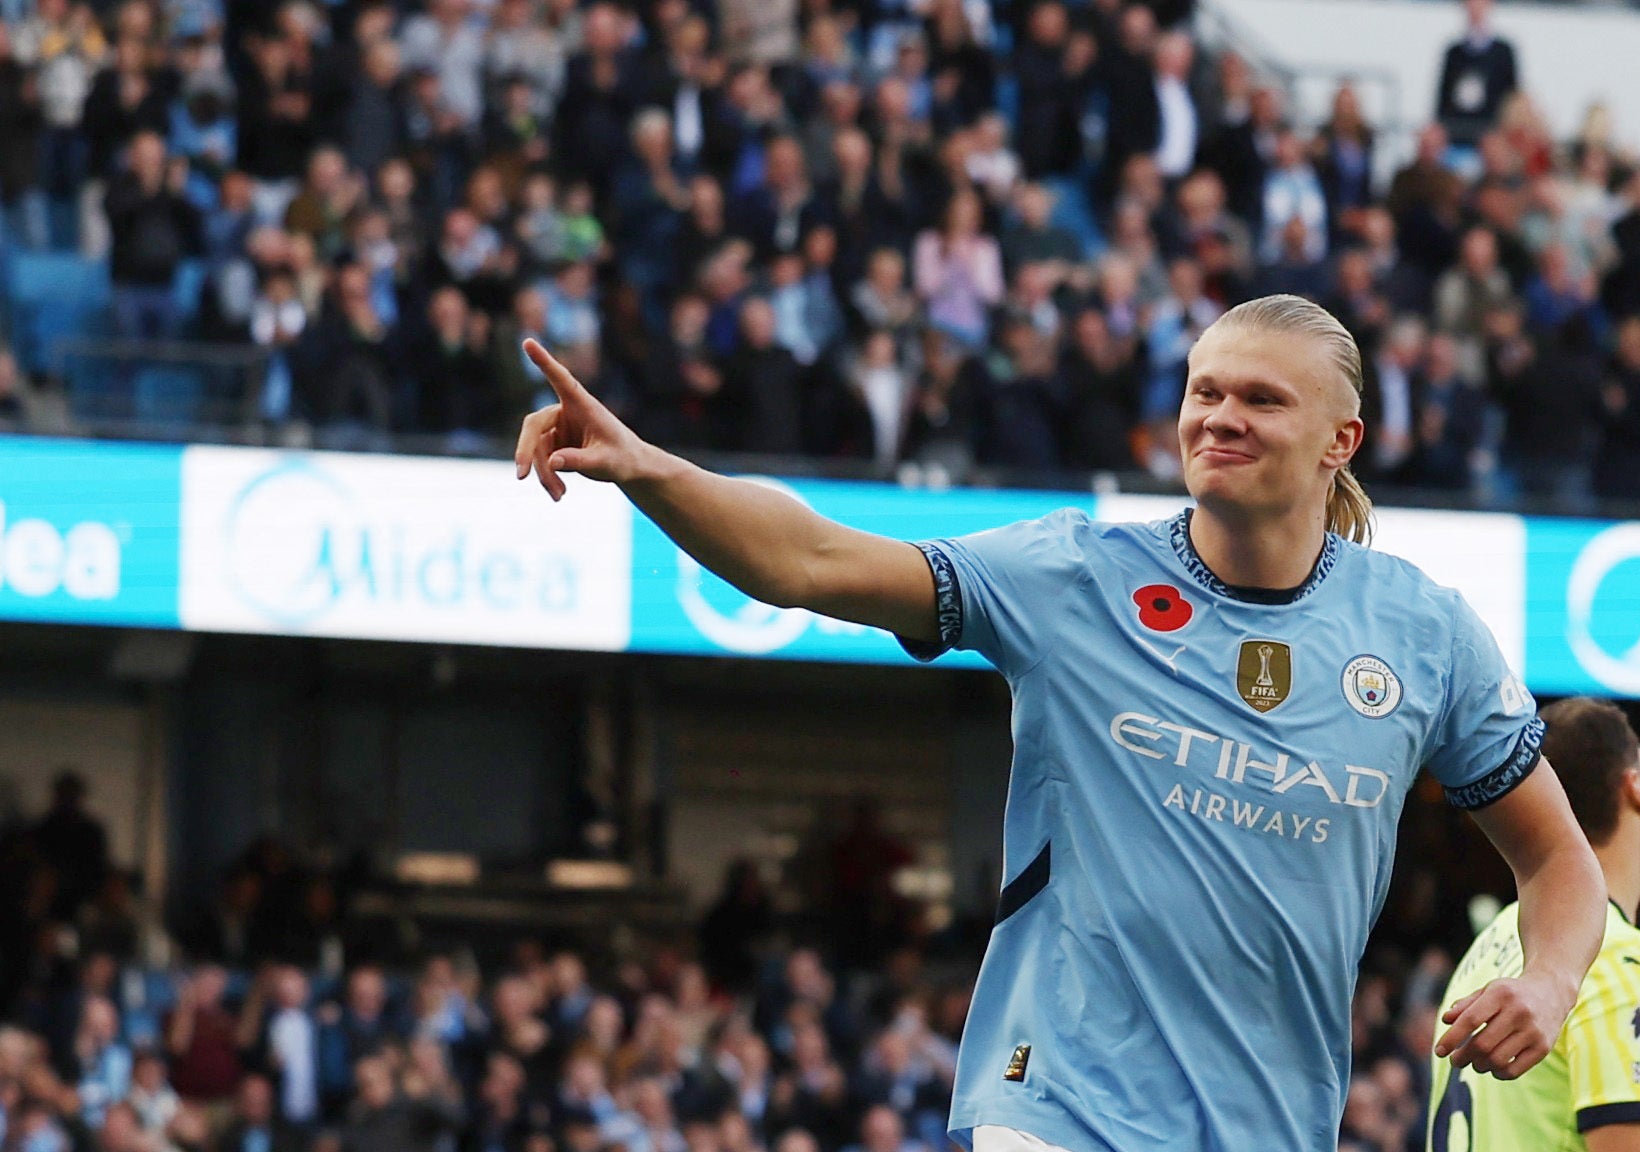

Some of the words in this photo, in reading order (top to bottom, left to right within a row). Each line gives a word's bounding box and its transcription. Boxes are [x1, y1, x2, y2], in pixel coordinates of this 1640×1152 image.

[0, 499, 121, 600] ea
[1347, 659, 1394, 682] MANCHESTER
[1251, 686, 1276, 697] FIFA
[1362, 706, 1380, 715] CITY
[1109, 711, 1390, 808] ETIHAD
[1162, 783, 1331, 843] AIRWAYS
